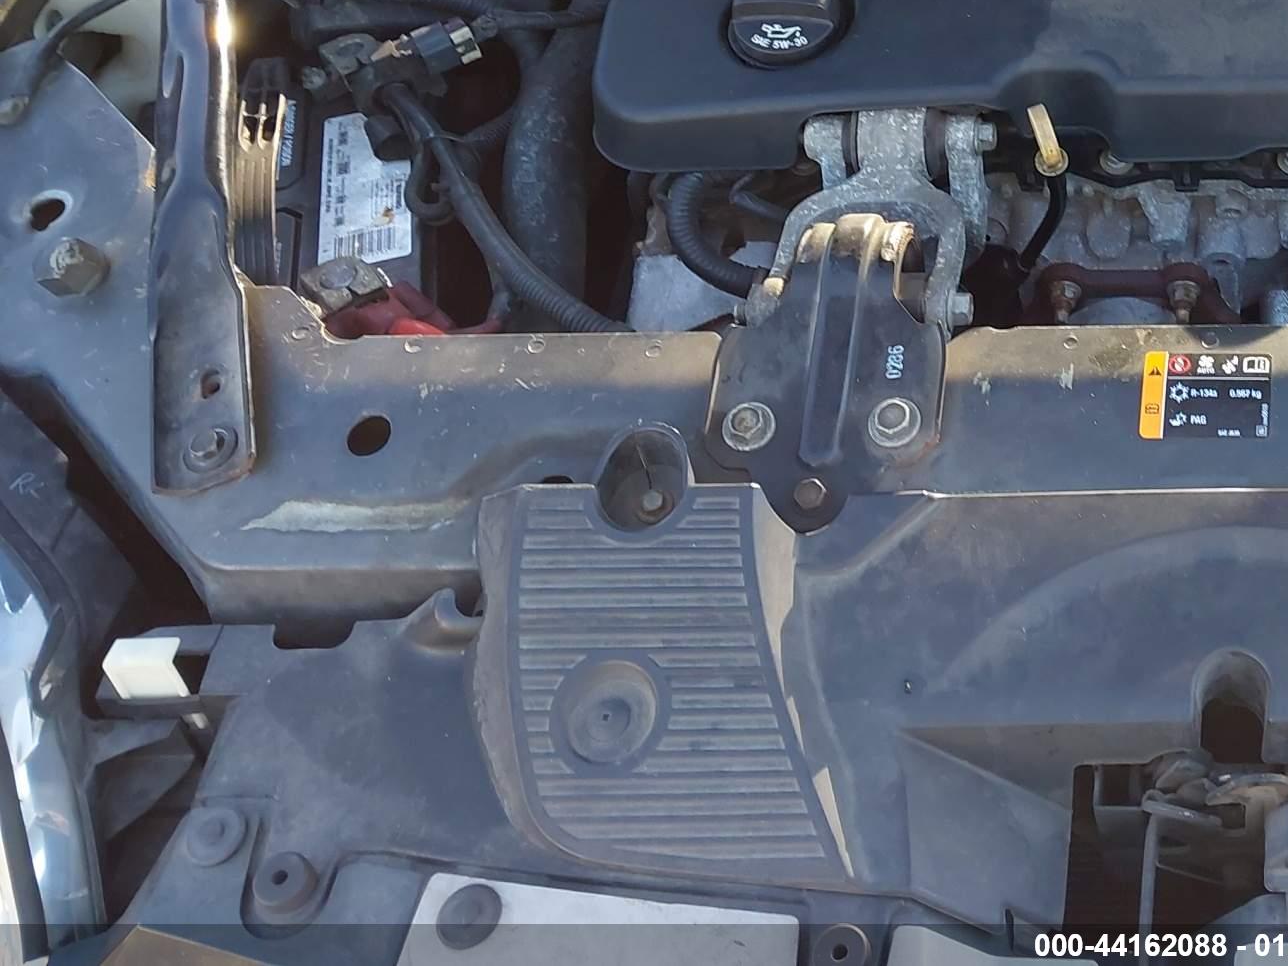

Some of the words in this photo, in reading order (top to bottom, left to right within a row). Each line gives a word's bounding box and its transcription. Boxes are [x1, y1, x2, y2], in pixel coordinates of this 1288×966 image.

[751, 34, 771, 48] SAE
[772, 35, 809, 49] 5W-30
[1190, 388, 1218, 398] R-134a
[1190, 414, 1207, 425] PAG
